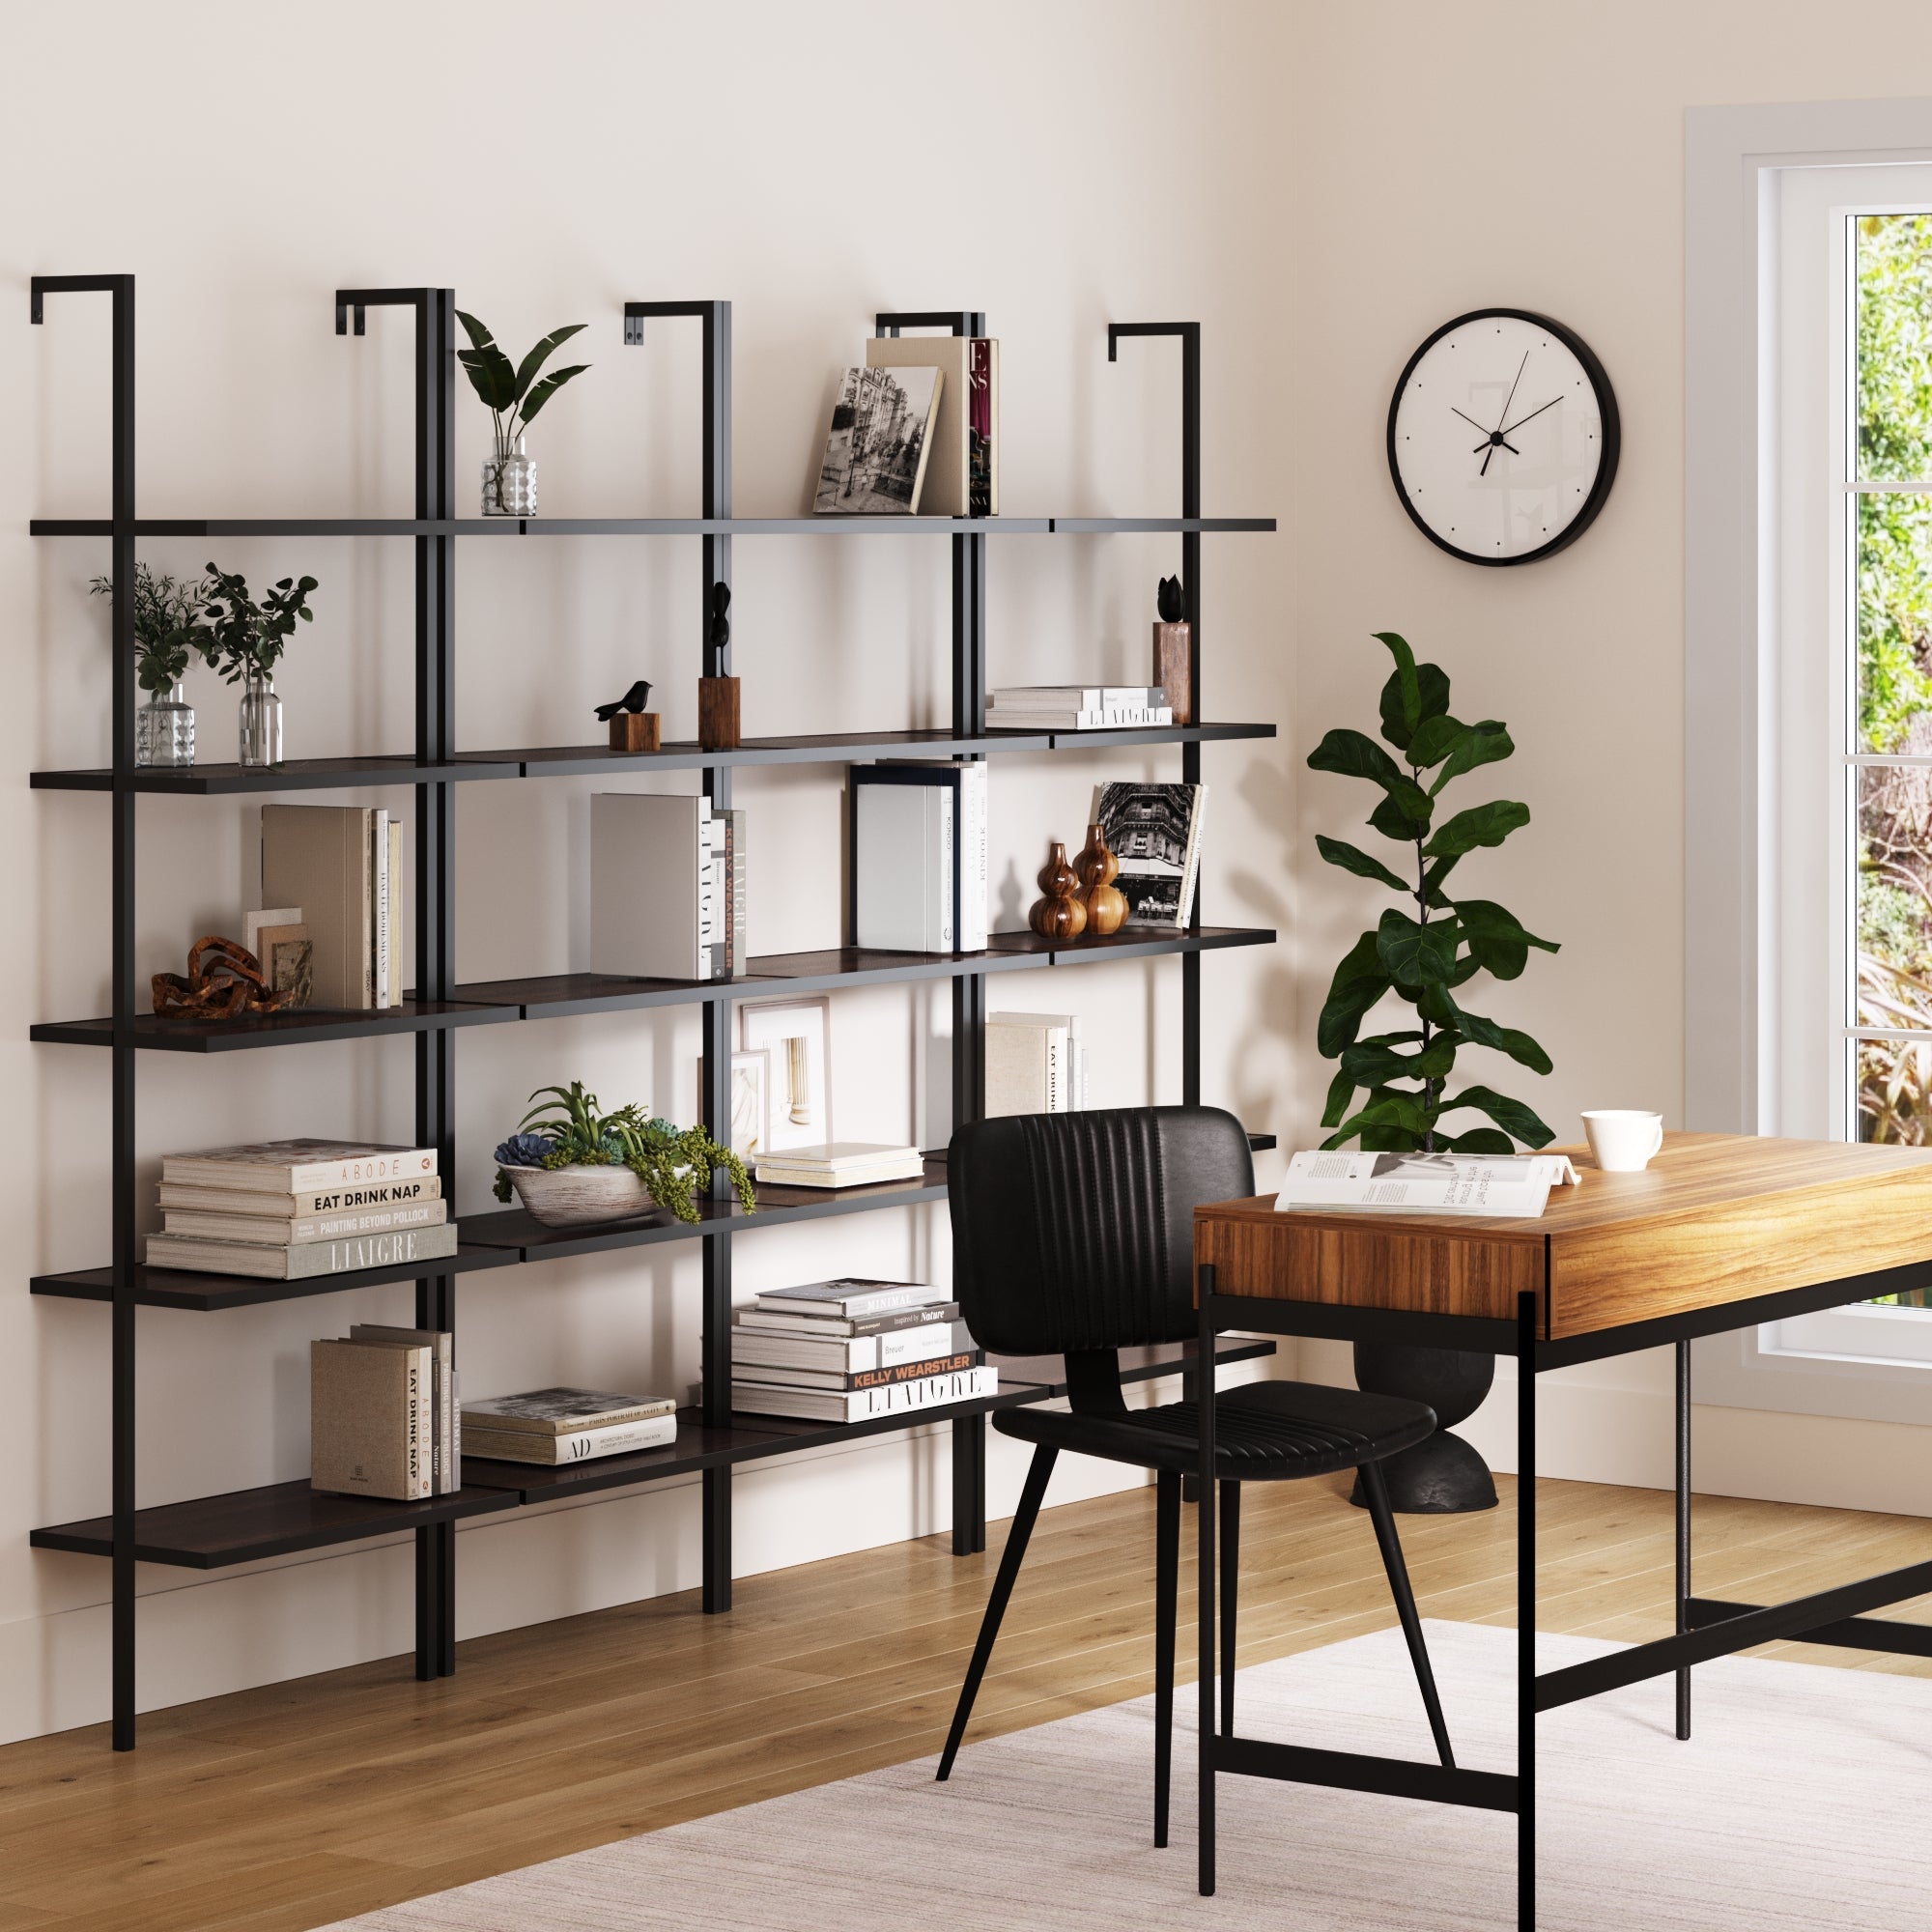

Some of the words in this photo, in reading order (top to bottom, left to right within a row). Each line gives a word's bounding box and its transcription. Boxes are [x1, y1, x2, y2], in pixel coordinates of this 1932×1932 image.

[734, 852, 746, 936] LIAIGRE
[342, 1159, 400, 1180] ABODE
[314, 1195, 340, 1211] EAT
[344, 1188, 388, 1207] DRINK
[391, 1184, 421, 1200] NAP
[320, 1217, 357, 1235] PAINTING
[359, 1212, 391, 1229] BEYOND
[393, 1208, 429, 1224] POLLOCK
[331, 1233, 417, 1271] LIAIGRE
[867, 1294, 911, 1310] MINIMAL
[895, 1314, 913, 1326] Inspired
[921, 1310, 944, 1322] Nature
[885, 1346, 904, 1354] Breuer
[854, 1370, 892, 1388] KELLY
[895, 1355, 970, 1380] WEARSTLER
[567, 1438, 591, 1461] AD
